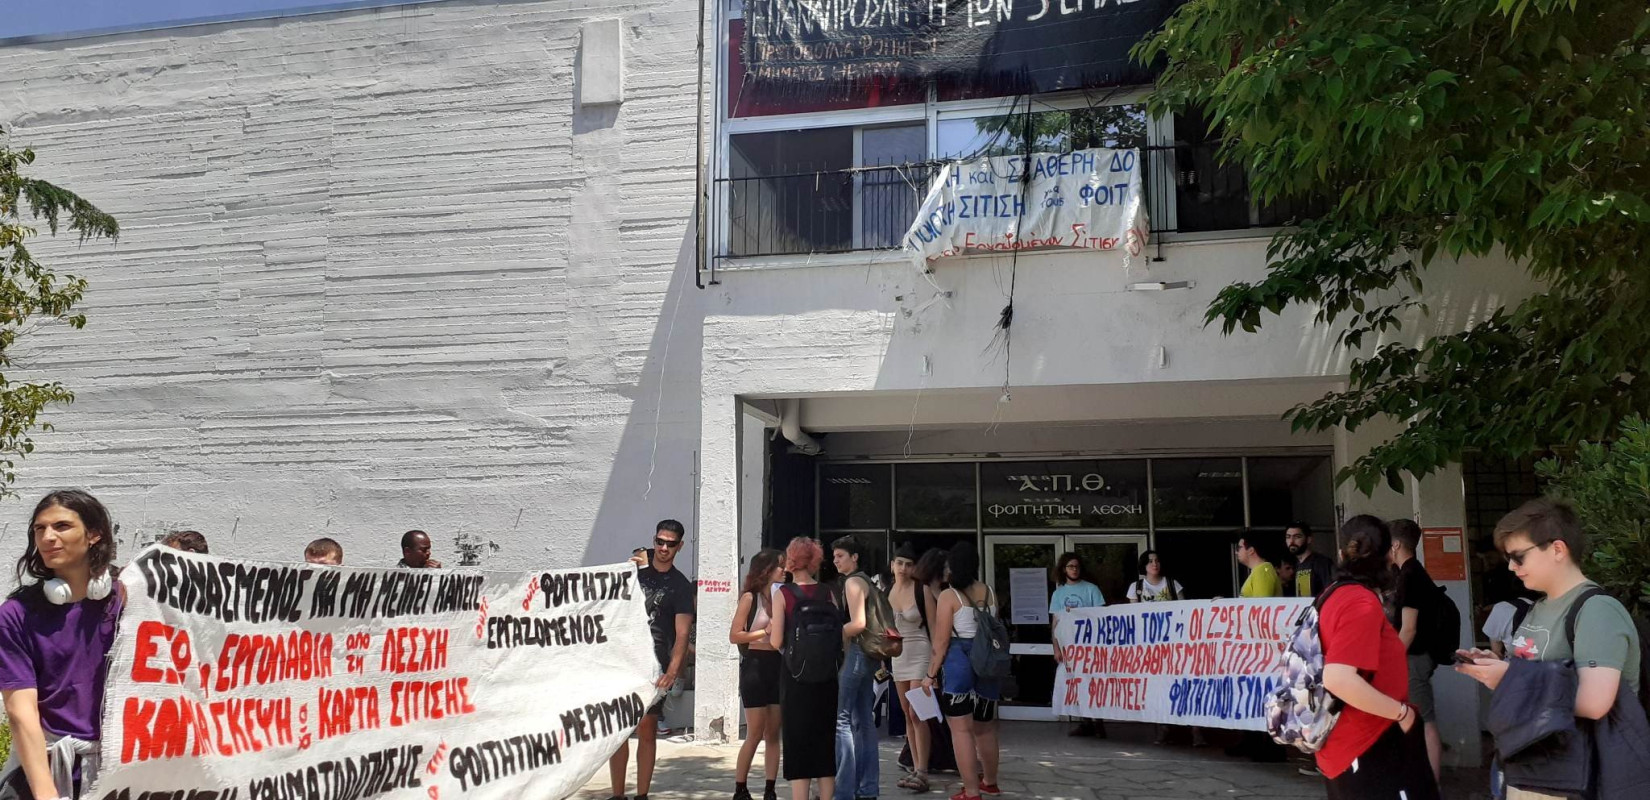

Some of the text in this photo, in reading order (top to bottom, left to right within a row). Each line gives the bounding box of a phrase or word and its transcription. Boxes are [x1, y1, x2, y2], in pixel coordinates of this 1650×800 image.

[1007, 152, 1094, 184] ΣΑΘΕΡΗ
[959, 194, 1026, 219] ΣΙΤΙΣΗ
[136, 548, 313, 624] ΠΕΙΝΑΣΜΕΝΟΣ
[338, 571, 377, 619] ΜΗ
[371, 570, 433, 619] ΜΕΙΝΕΙ
[432, 573, 484, 614] ΚΑΝΕΙΣ
[539, 570, 633, 609] ΦΟΙΤΗΤΗΣ
[487, 613, 608, 649] ΕΡΓΑΖΟΜΕΝΟΣ
[1074, 618, 1092, 644] ΤΑ
[1096, 614, 1135, 645] ΚΕΡΔΗ
[1141, 611, 1173, 643] ΤΟΥΣ
[1189, 608, 1204, 641] ΟΙ
[215, 629, 334, 692] ΕΡΓΟΛΑΒΙΑ
[381, 626, 449, 674] ΛΕΣΧΗ
[1110, 642, 1217, 677] ΑΝΑΒΑΘΜΙΣΜΕΝΗ
[1217, 640, 1274, 675] ΣΙΤΙΣΗ
[1088, 677, 1148, 711] ΦΟΙΤΗΤΕΣ!
[1169, 675, 1233, 719] ΦΟΙΤΗΤΙΚΟΙ
[1235, 675, 1281, 720] ΣΥΛΛ
[120, 695, 214, 764] ΚΑΜΑ
[209, 696, 293, 757] ΣΚΕΨΗ
[318, 686, 380, 740] ΚΑΡΤΑ
[389, 677, 476, 727] ΣΙΤΙΣΗΣ
[450, 730, 562, 792] ΦΟΙΤΗΤΙΚΗ
[559, 692, 645, 748] ΜΕΡΙΜΝΑ
